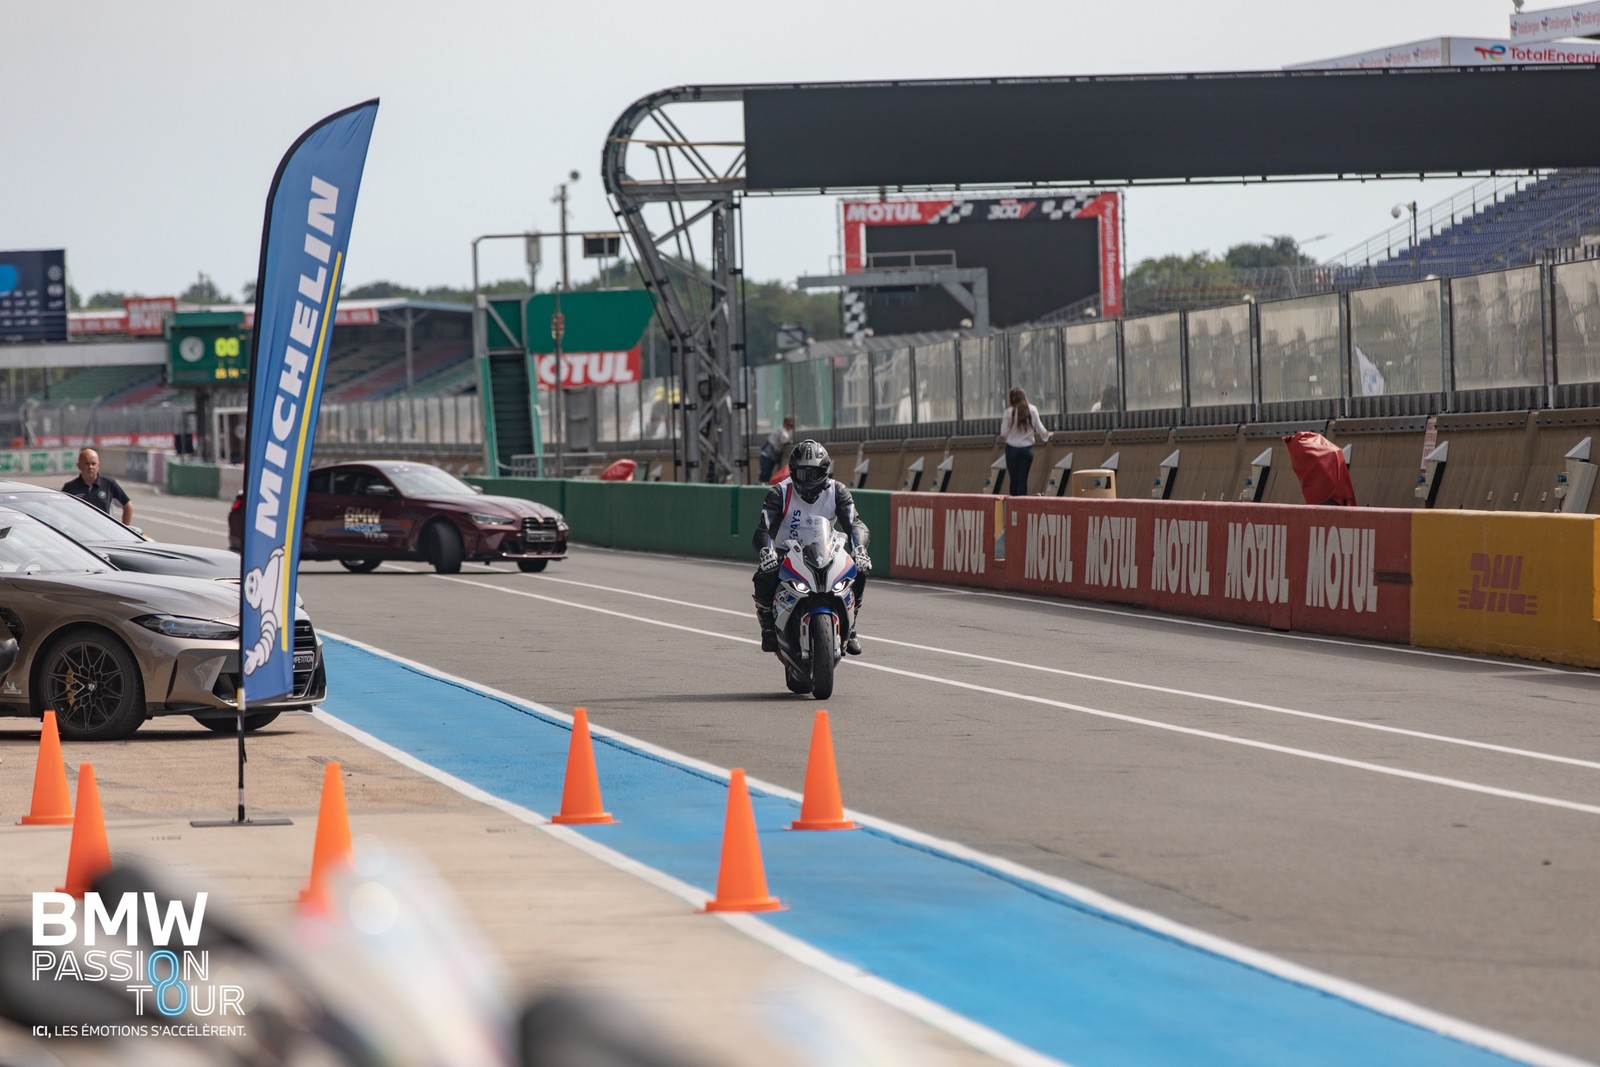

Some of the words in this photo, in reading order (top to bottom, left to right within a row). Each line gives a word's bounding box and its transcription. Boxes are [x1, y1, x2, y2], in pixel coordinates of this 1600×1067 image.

[848, 202, 921, 222] MOTUL
[255, 175, 339, 540] MICHELIN
[540, 352, 634, 385] OTUL
[896, 506, 934, 570] MOTUL
[943, 508, 985, 574] MOTUL
[1024, 513, 1073, 583] MOTUL
[1085, 515, 1138, 590] MOTUL
[1151, 518, 1210, 597] MOTUL
[1224, 521, 1289, 604] MOTUL
[1305, 525, 1378, 613] MOTUL
